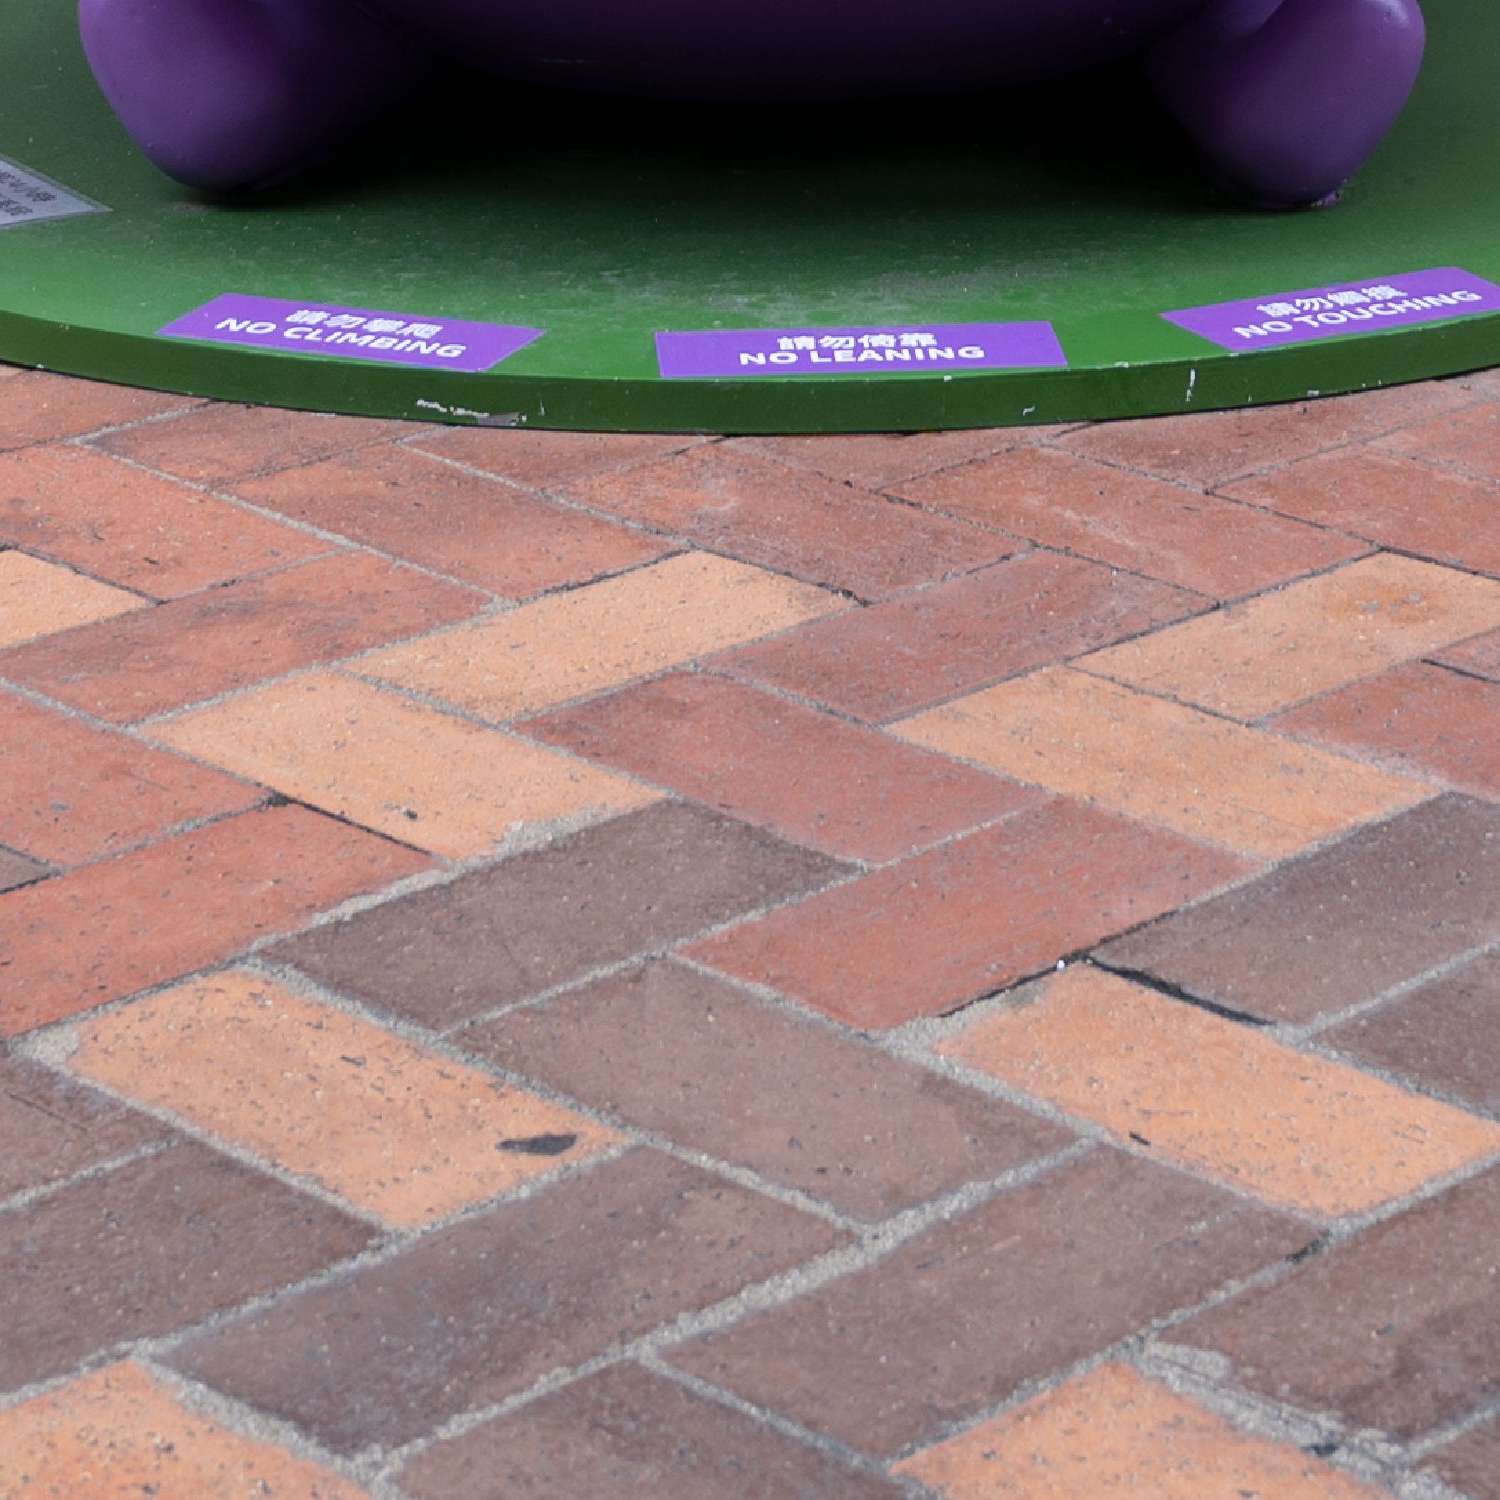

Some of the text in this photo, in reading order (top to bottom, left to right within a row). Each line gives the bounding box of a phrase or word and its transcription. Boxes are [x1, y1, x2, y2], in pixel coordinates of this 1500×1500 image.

[1232, 290, 1482, 339] NO TOUCHING
[214, 317, 467, 358] NO CLIMBING
[739, 345, 985, 365] NO LEANING
